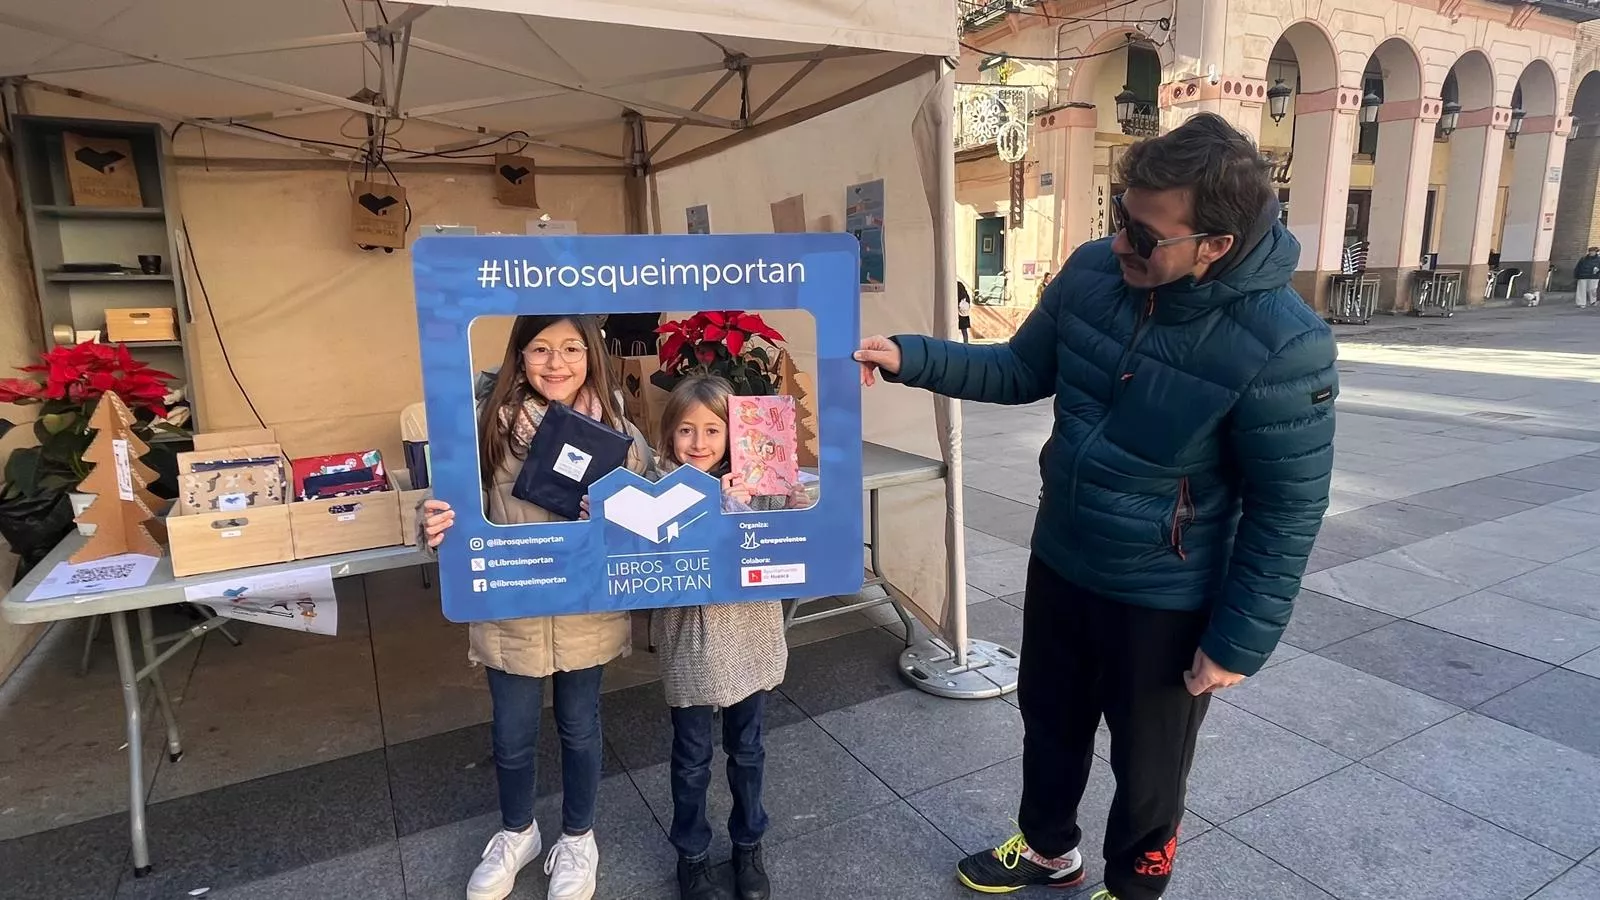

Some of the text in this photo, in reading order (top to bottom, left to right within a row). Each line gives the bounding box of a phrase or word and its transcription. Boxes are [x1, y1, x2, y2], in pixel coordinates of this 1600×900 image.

[477, 257, 806, 293] #librosqueimportan
[486, 536, 564, 548] @librosqueimportan
[488, 557, 554, 568] @Librosimportan
[607, 557, 711, 577] LIBROS QUE
[489, 577, 567, 589] @librosqueimportan
[608, 573, 712, 596] IMPORTAN
